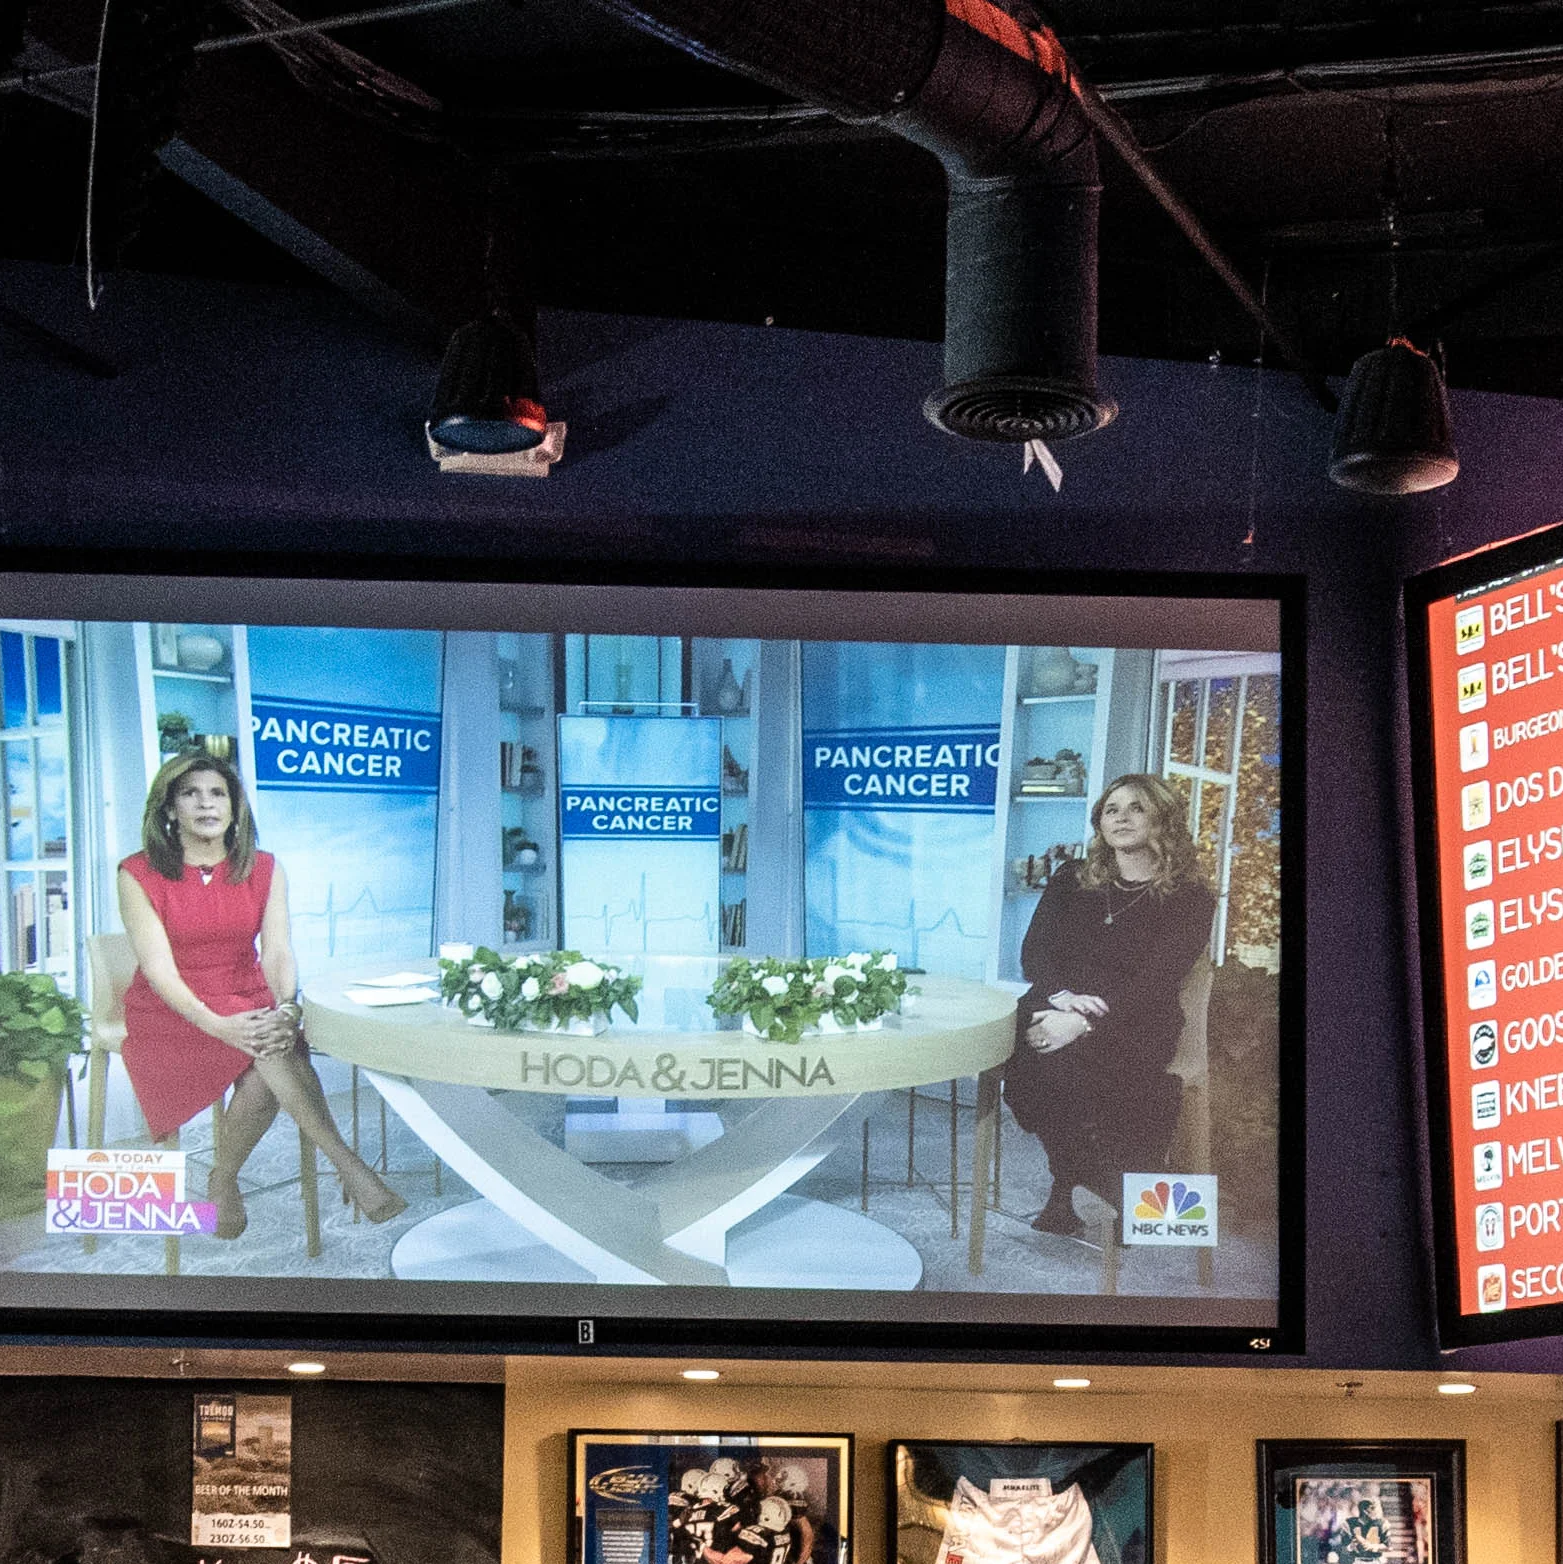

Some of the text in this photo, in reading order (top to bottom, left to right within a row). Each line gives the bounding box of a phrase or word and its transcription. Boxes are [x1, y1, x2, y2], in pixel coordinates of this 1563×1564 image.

[249, 716, 431, 753] PANCREATIC
[276, 749, 402, 778] CANCER
[814, 743, 1001, 769] PANCREATIC
[843, 772, 971, 798] CANCER
[1495, 775, 1544, 813] DOS
[566, 794, 719, 814] PANCREATIC
[591, 813, 693, 831] CANCER
[520, 1052, 836, 1092] HODA & JENNA
[111, 1151, 164, 1165] TODAY
[57, 1173, 160, 1200] HODA
[1132, 1223, 1209, 1237] NBC NEWS
[195, 1485, 288, 1497] BEER OF THE MONTH
